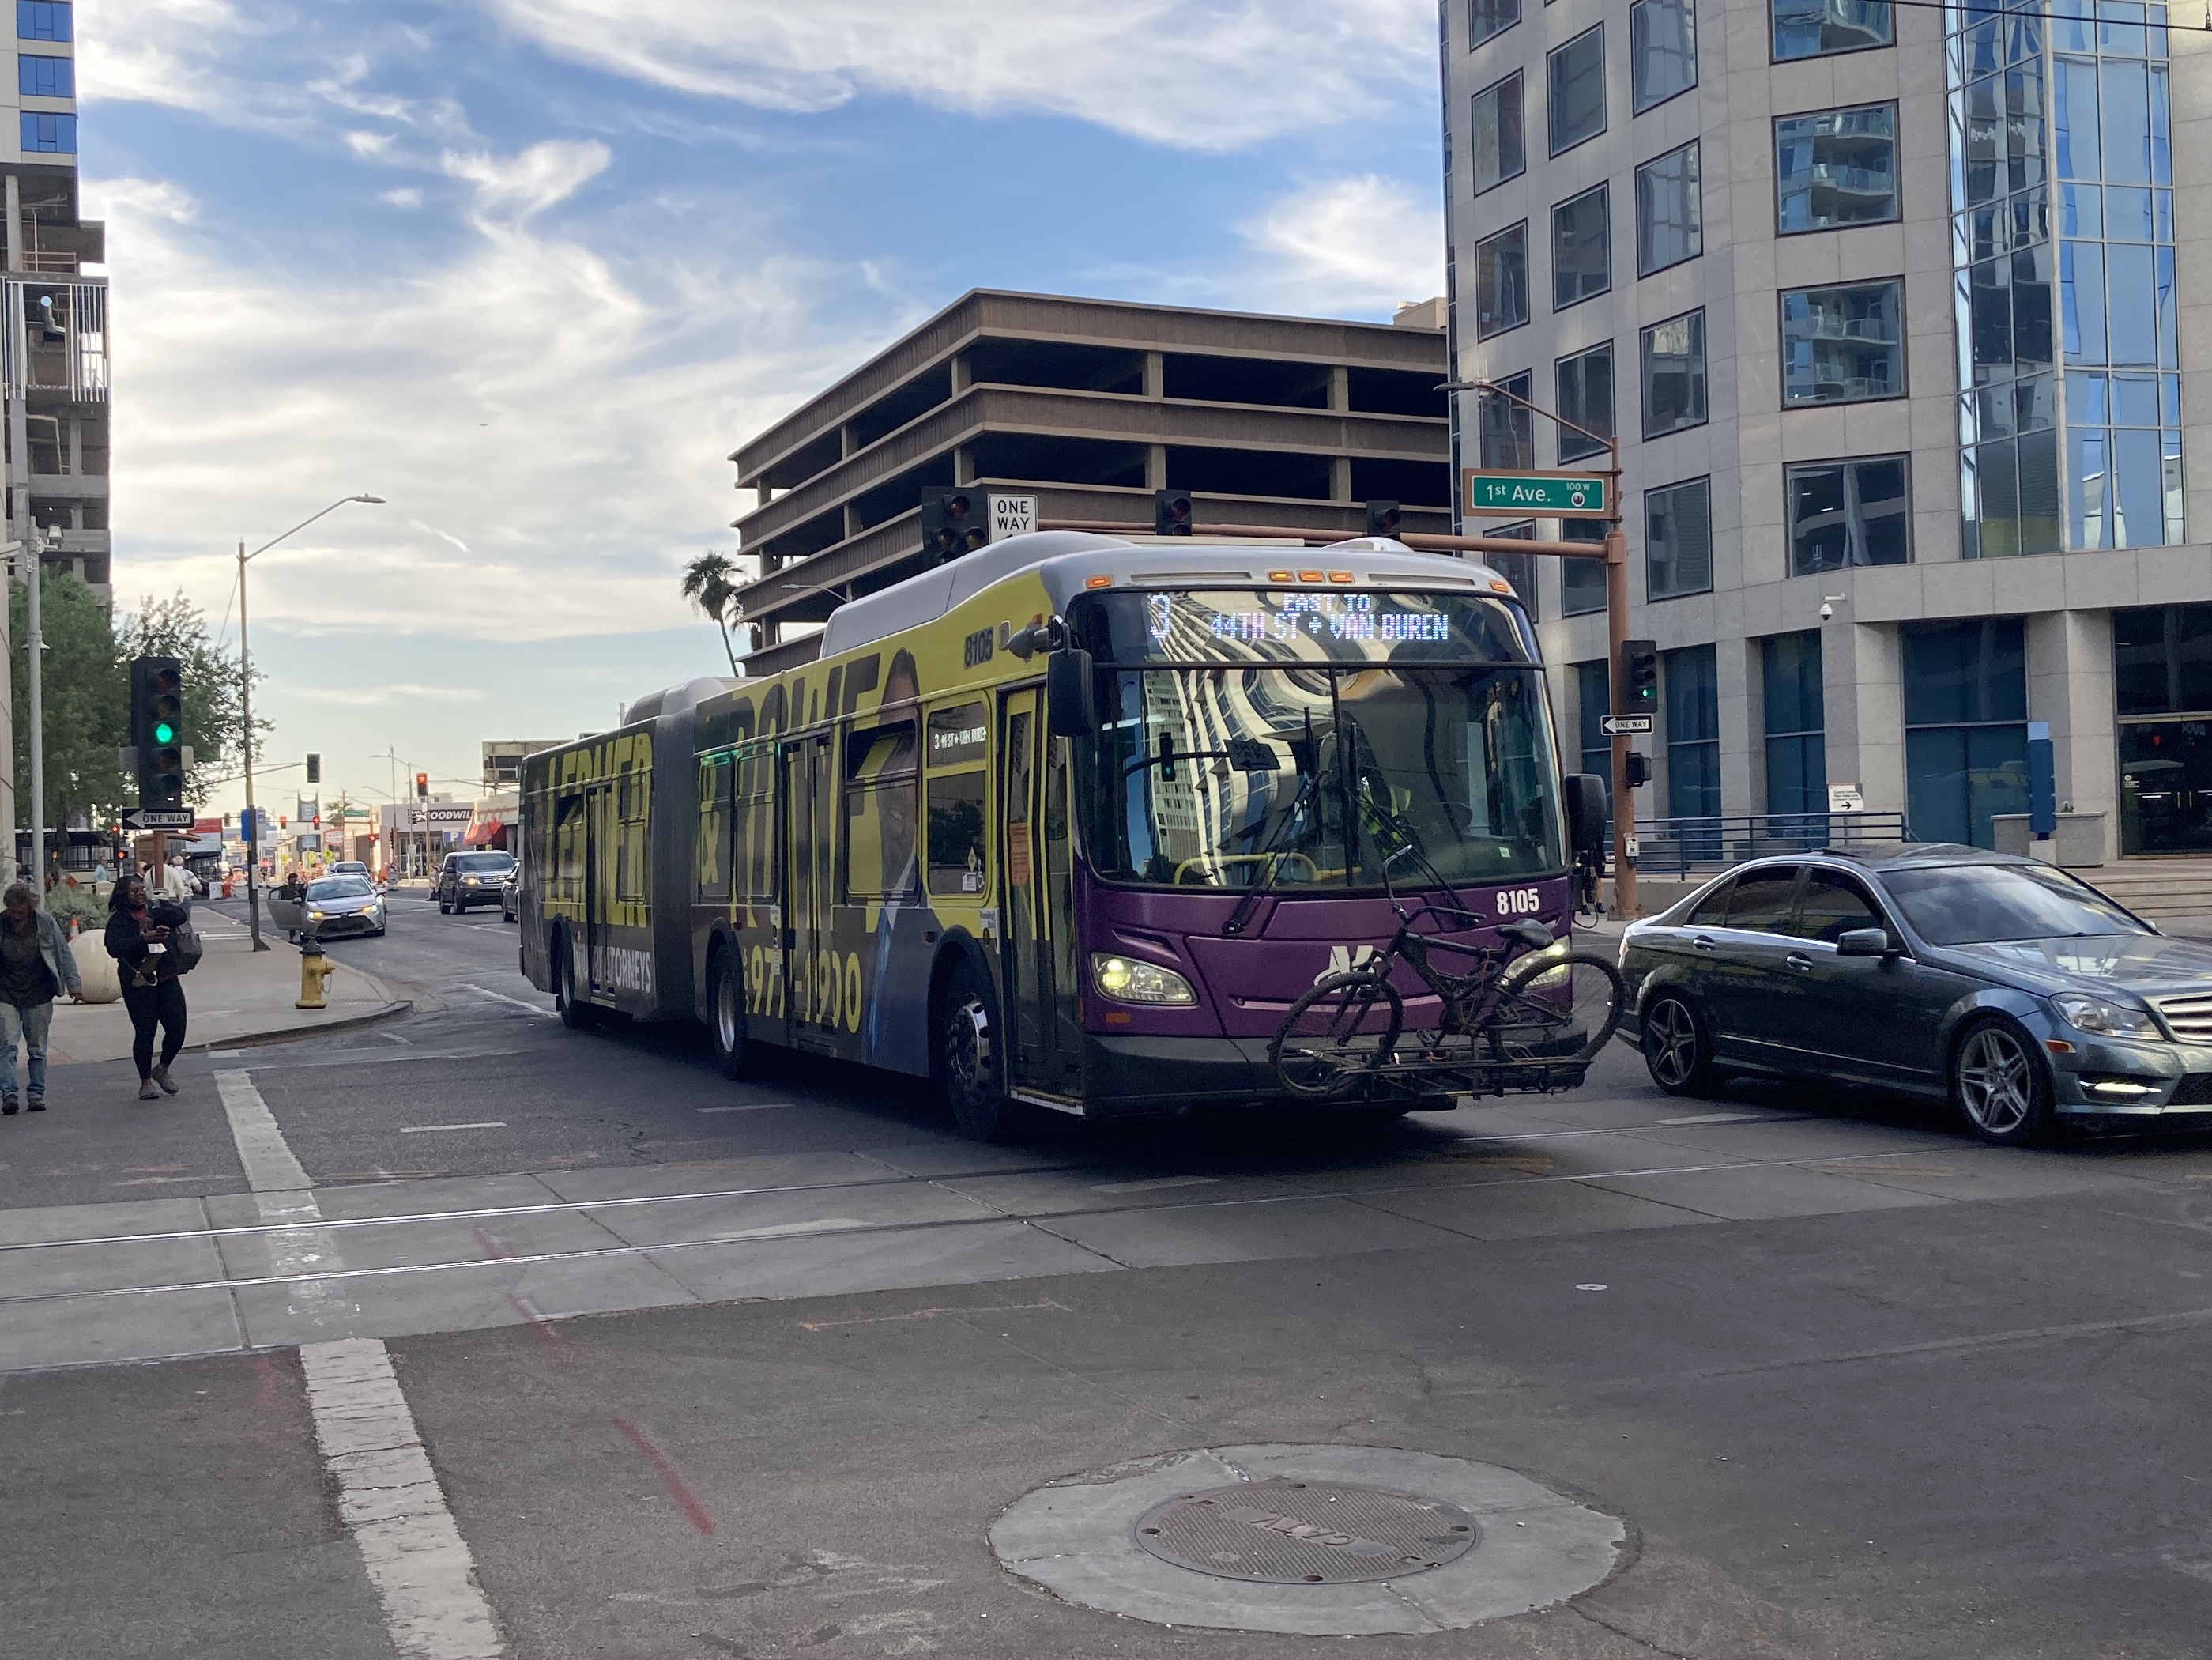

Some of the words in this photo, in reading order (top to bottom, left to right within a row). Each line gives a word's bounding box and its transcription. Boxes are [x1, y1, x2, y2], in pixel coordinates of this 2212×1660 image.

[1487, 484, 1506, 500] 1st
[1512, 485, 1551, 503] Ave.
[1566, 482, 1581, 491] 100
[998, 500, 1028, 514] ONE
[997, 516, 1030, 530] WAY
[1283, 594, 1336, 612] EAST
[1343, 594, 1371, 612] TO
[1149, 594, 1171, 639] 3
[1210, 613, 1265, 639] 44TH
[1273, 613, 1301, 639] ST
[1329, 613, 1374, 639] VAN
[1381, 613, 1449, 640] BUREN
[965, 629, 993, 666] 8105
[934, 734, 940, 749] 3
[971, 726, 986, 743] BURE
[143, 814, 162, 823] ONE
[167, 813, 187, 823] WAY
[424, 810, 473, 821] OODWIL
[450, 832, 459, 842] P
[1496, 888, 1540, 915] 8105
